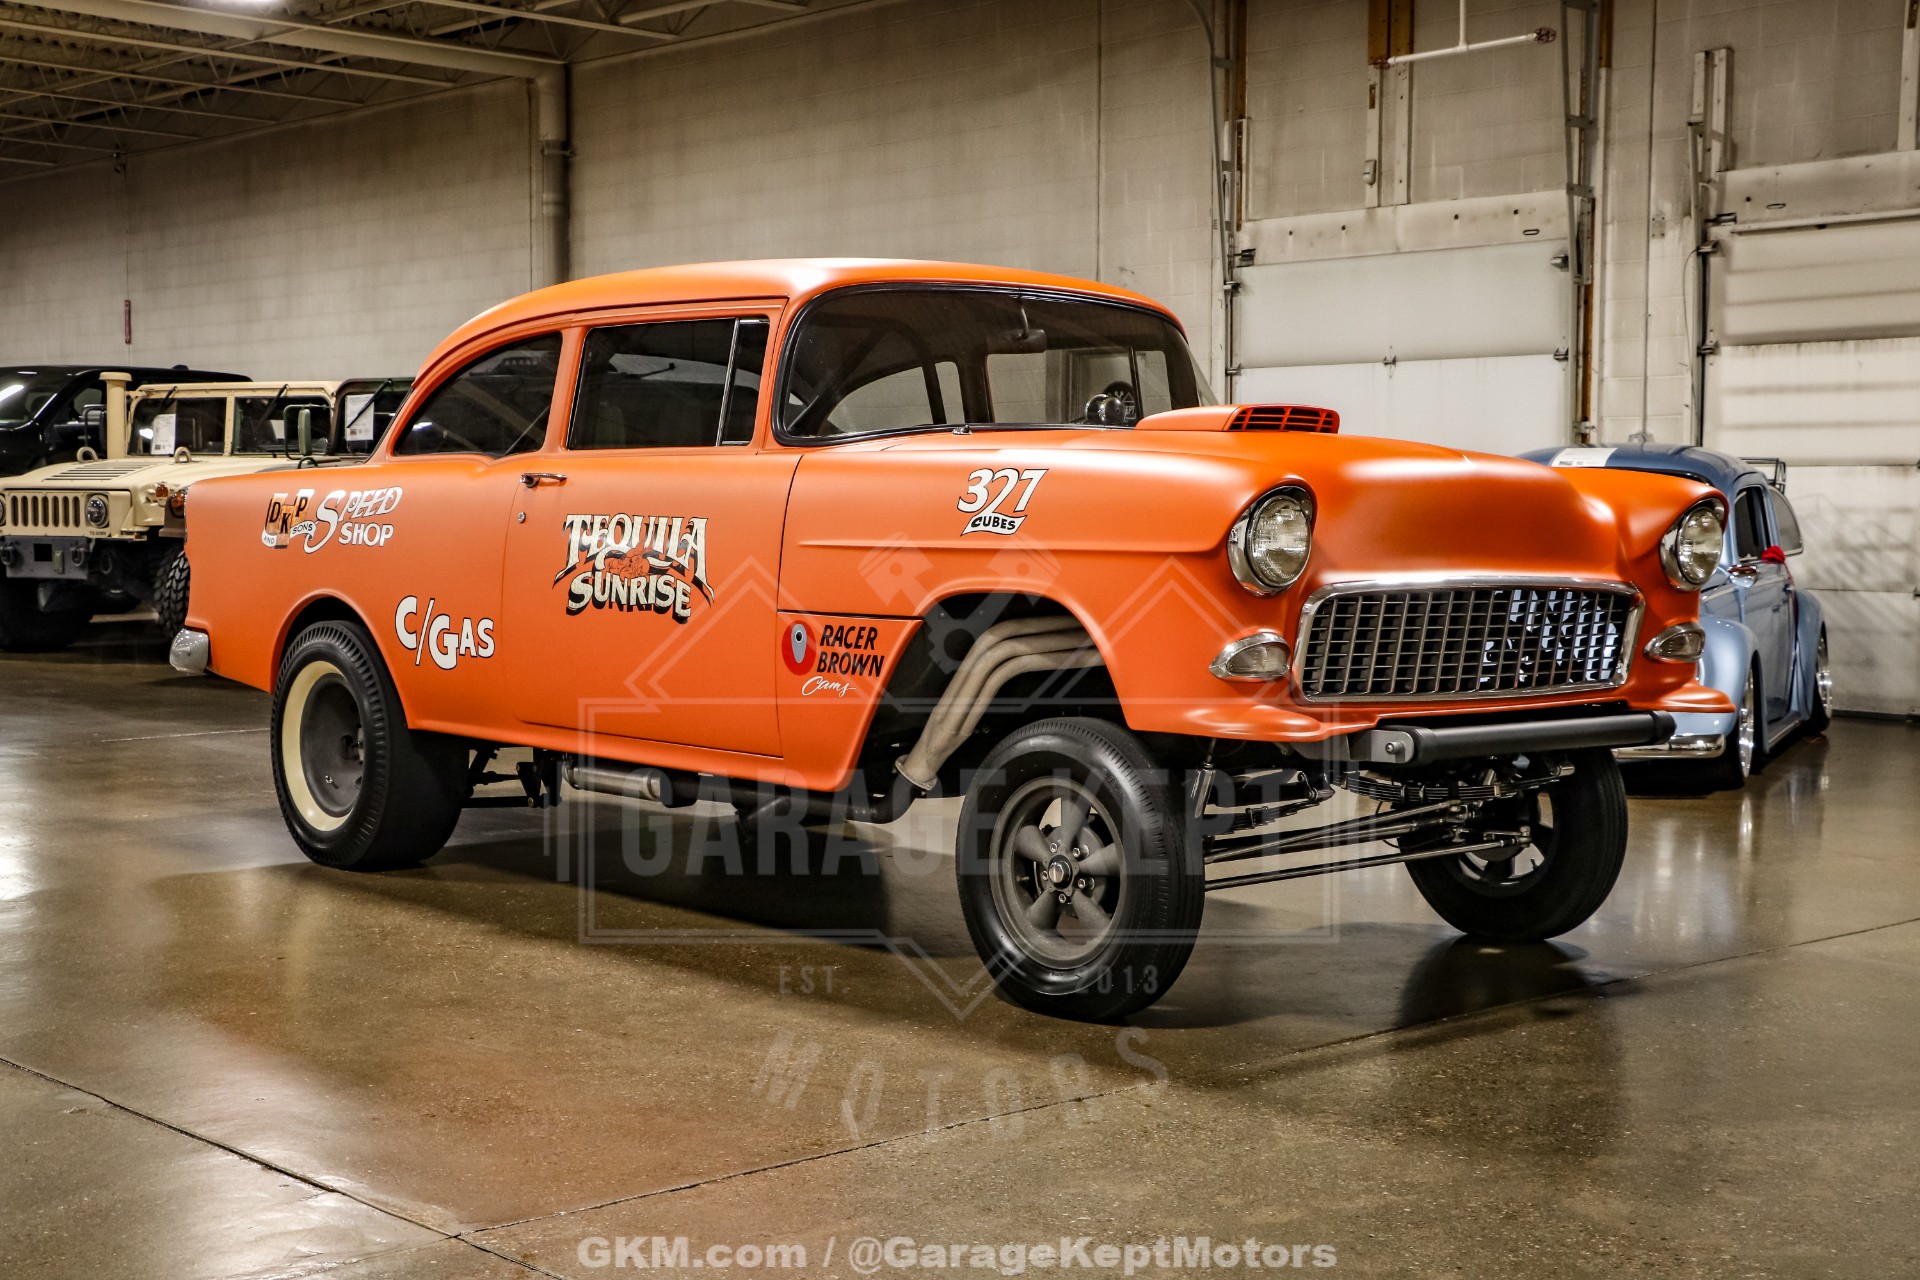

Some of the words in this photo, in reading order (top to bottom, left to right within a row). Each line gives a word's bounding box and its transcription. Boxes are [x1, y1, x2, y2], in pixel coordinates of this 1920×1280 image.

[957, 468, 1049, 513] 327
[292, 523, 313, 535] SONS
[303, 487, 403, 554] SPEED
[970, 516, 1016, 530] CUBES
[338, 522, 394, 547] SHOP
[552, 513, 715, 608] TEQUILA
[566, 571, 692, 624] SUNRISE
[819, 624, 878, 650] RACER
[816, 651, 885, 677] BROWN
[801, 675, 857, 697] Cams
